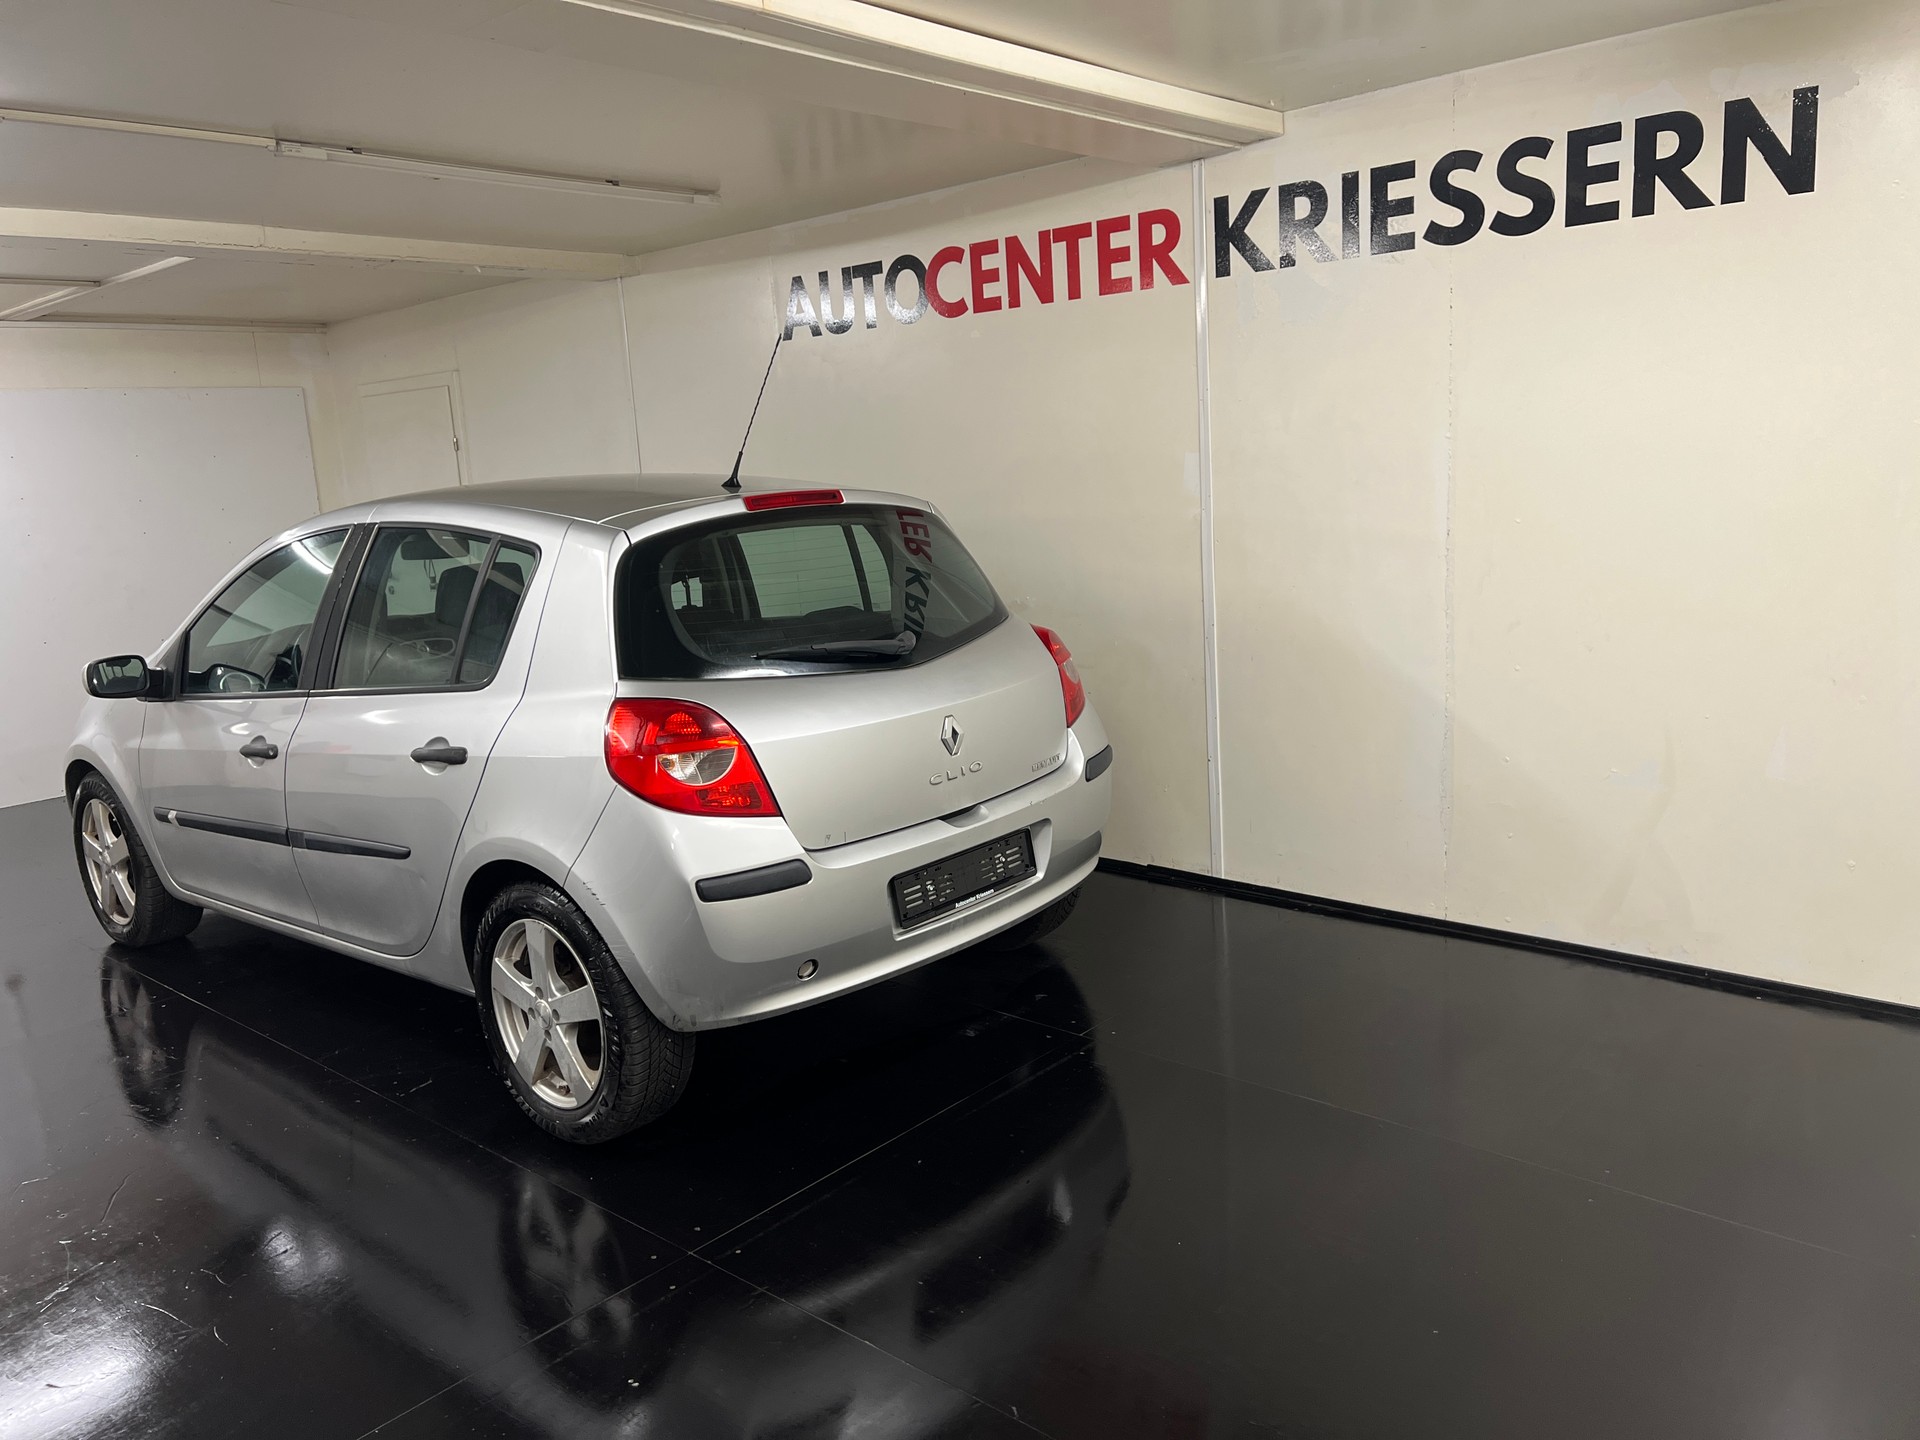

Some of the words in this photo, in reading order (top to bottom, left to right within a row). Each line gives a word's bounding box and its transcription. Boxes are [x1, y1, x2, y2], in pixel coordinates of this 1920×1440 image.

[782, 208, 1190, 341] AUTOCENTER
[1213, 85, 1819, 278] KRIESSERN
[929, 760, 983, 786] CLIO
